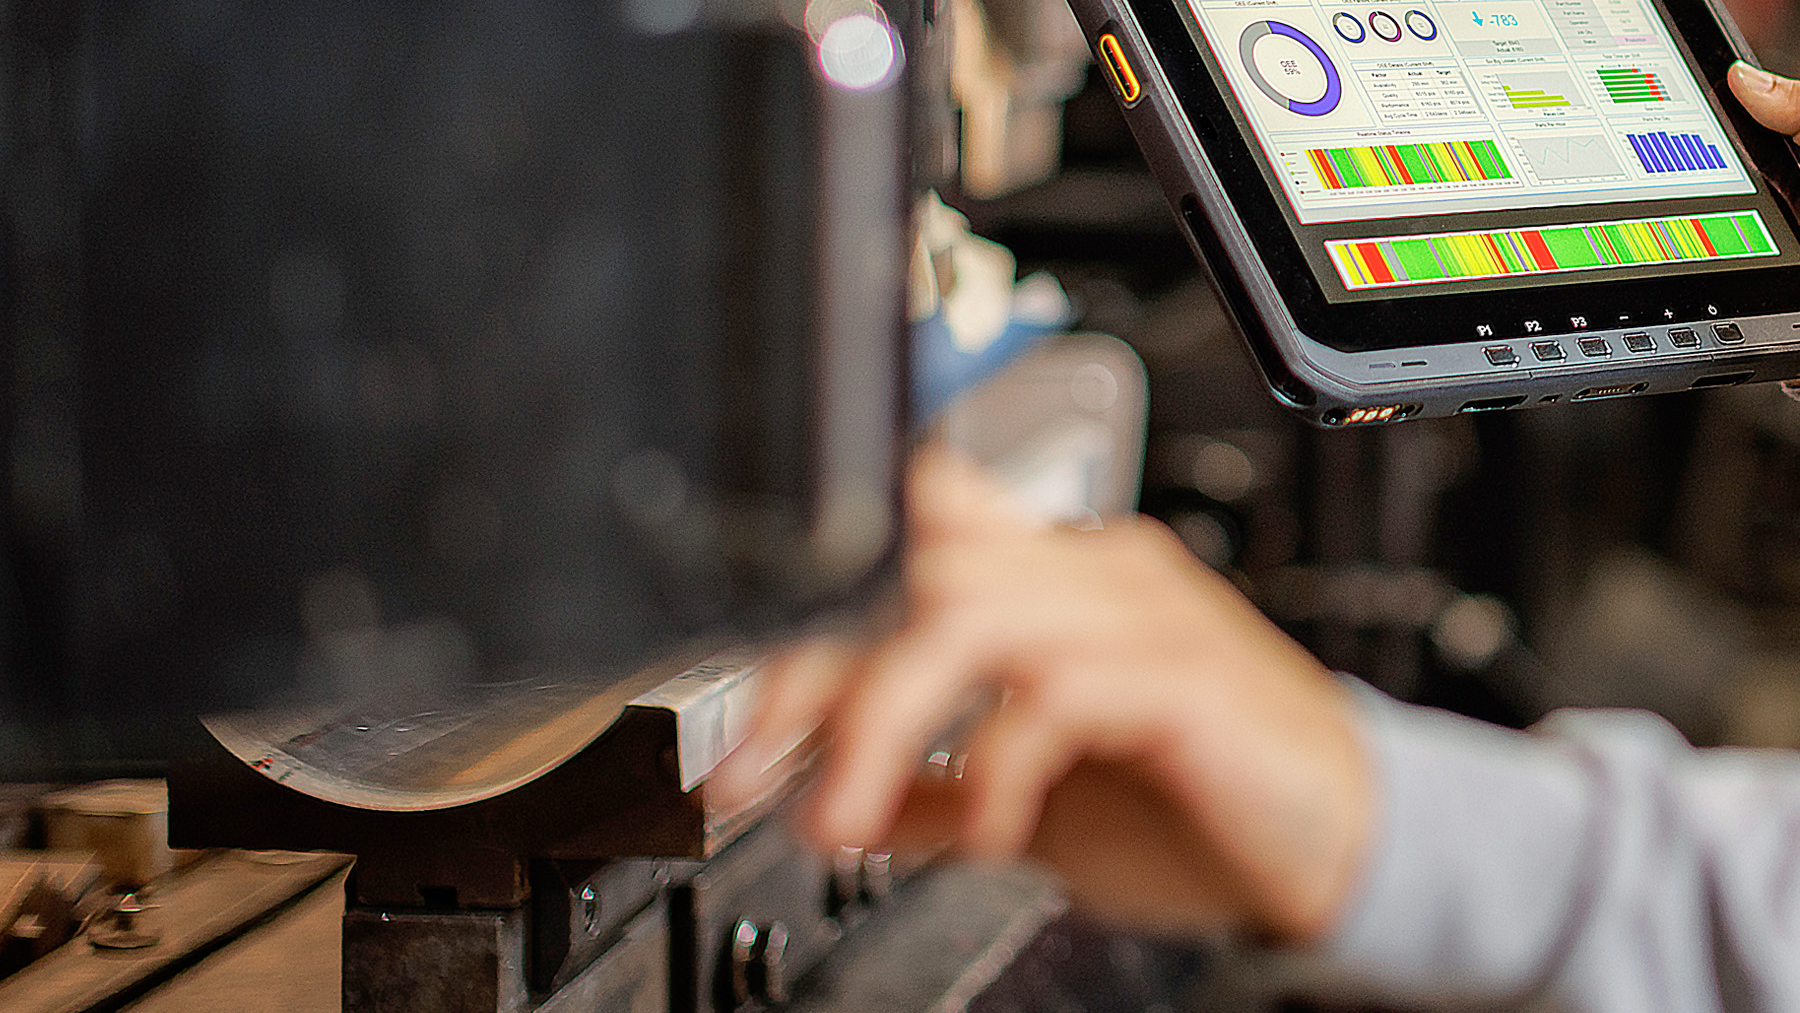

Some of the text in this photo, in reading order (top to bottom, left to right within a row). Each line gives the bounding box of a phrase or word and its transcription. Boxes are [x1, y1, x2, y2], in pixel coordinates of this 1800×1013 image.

[1489, 14, 1518, 26] -783
[1280, 60, 1298, 68] OEE
[1524, 319, 1542, 332] P2
[1570, 315, 1587, 328] P3
[1476, 325, 1492, 336] P1
